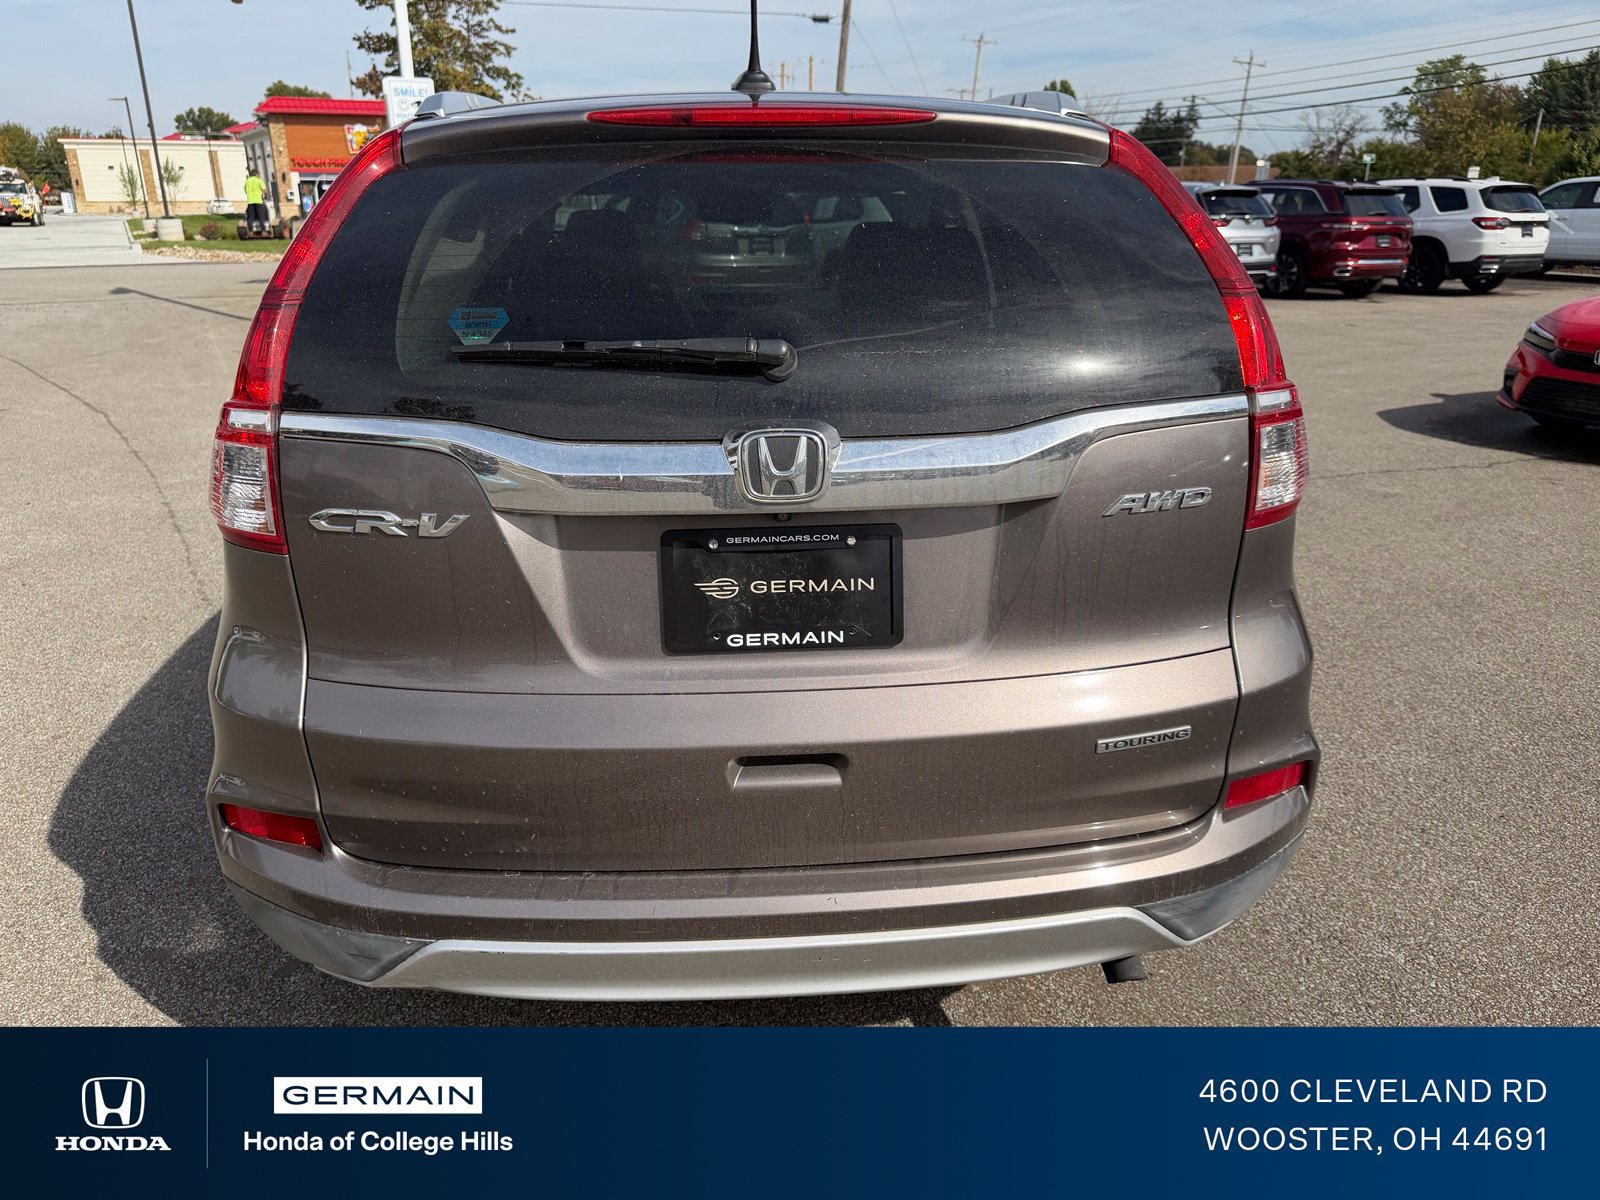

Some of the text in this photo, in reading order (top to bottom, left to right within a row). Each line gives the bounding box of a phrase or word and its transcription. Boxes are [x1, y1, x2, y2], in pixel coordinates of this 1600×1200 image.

[1101, 486, 1212, 518] AWD
[308, 507, 471, 537] CR-V
[726, 533, 840, 545] GERMAINCARS.COM
[750, 577, 875, 595] GERMAIN
[726, 630, 844, 648] GERMAIN
[1101, 729, 1190, 751] TOURING
